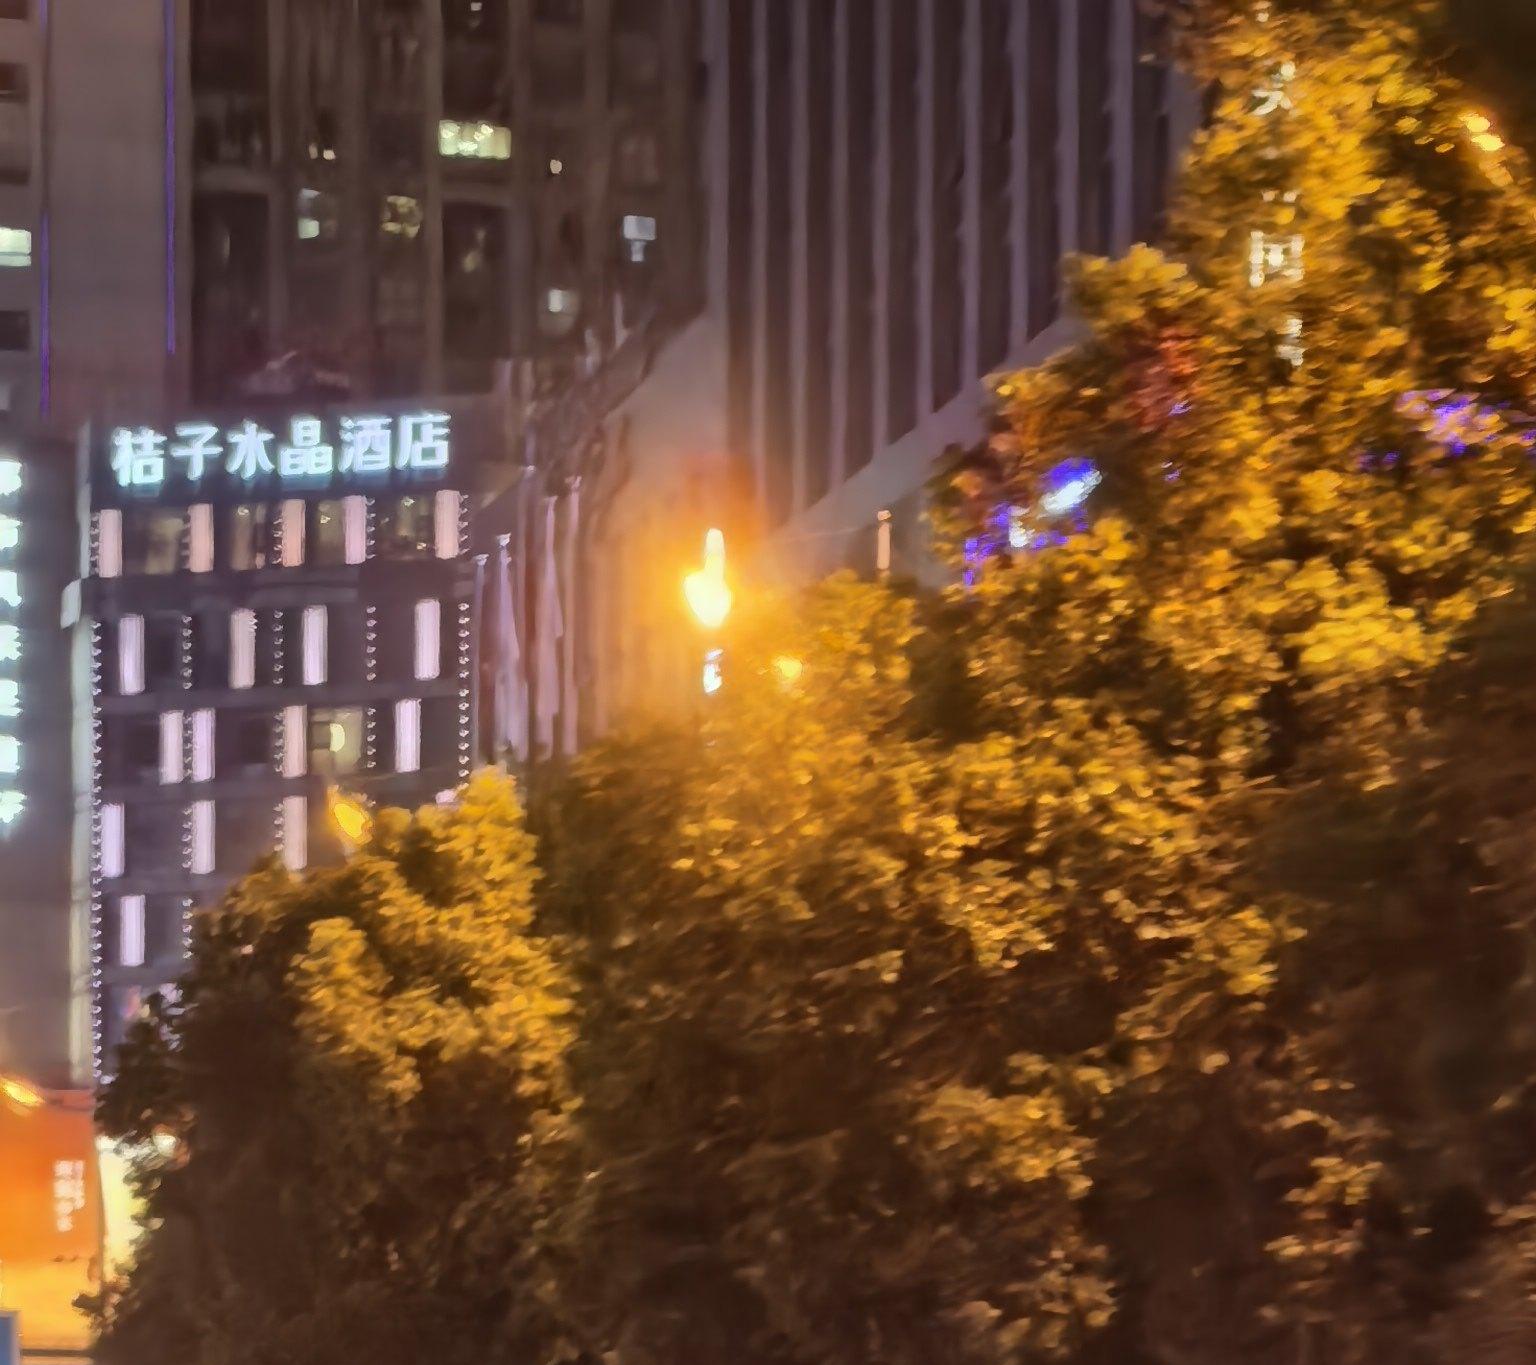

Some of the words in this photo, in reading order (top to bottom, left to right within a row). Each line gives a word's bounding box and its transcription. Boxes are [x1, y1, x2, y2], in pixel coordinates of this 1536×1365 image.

[111, 412, 451, 487] 桔子水晶酒店
